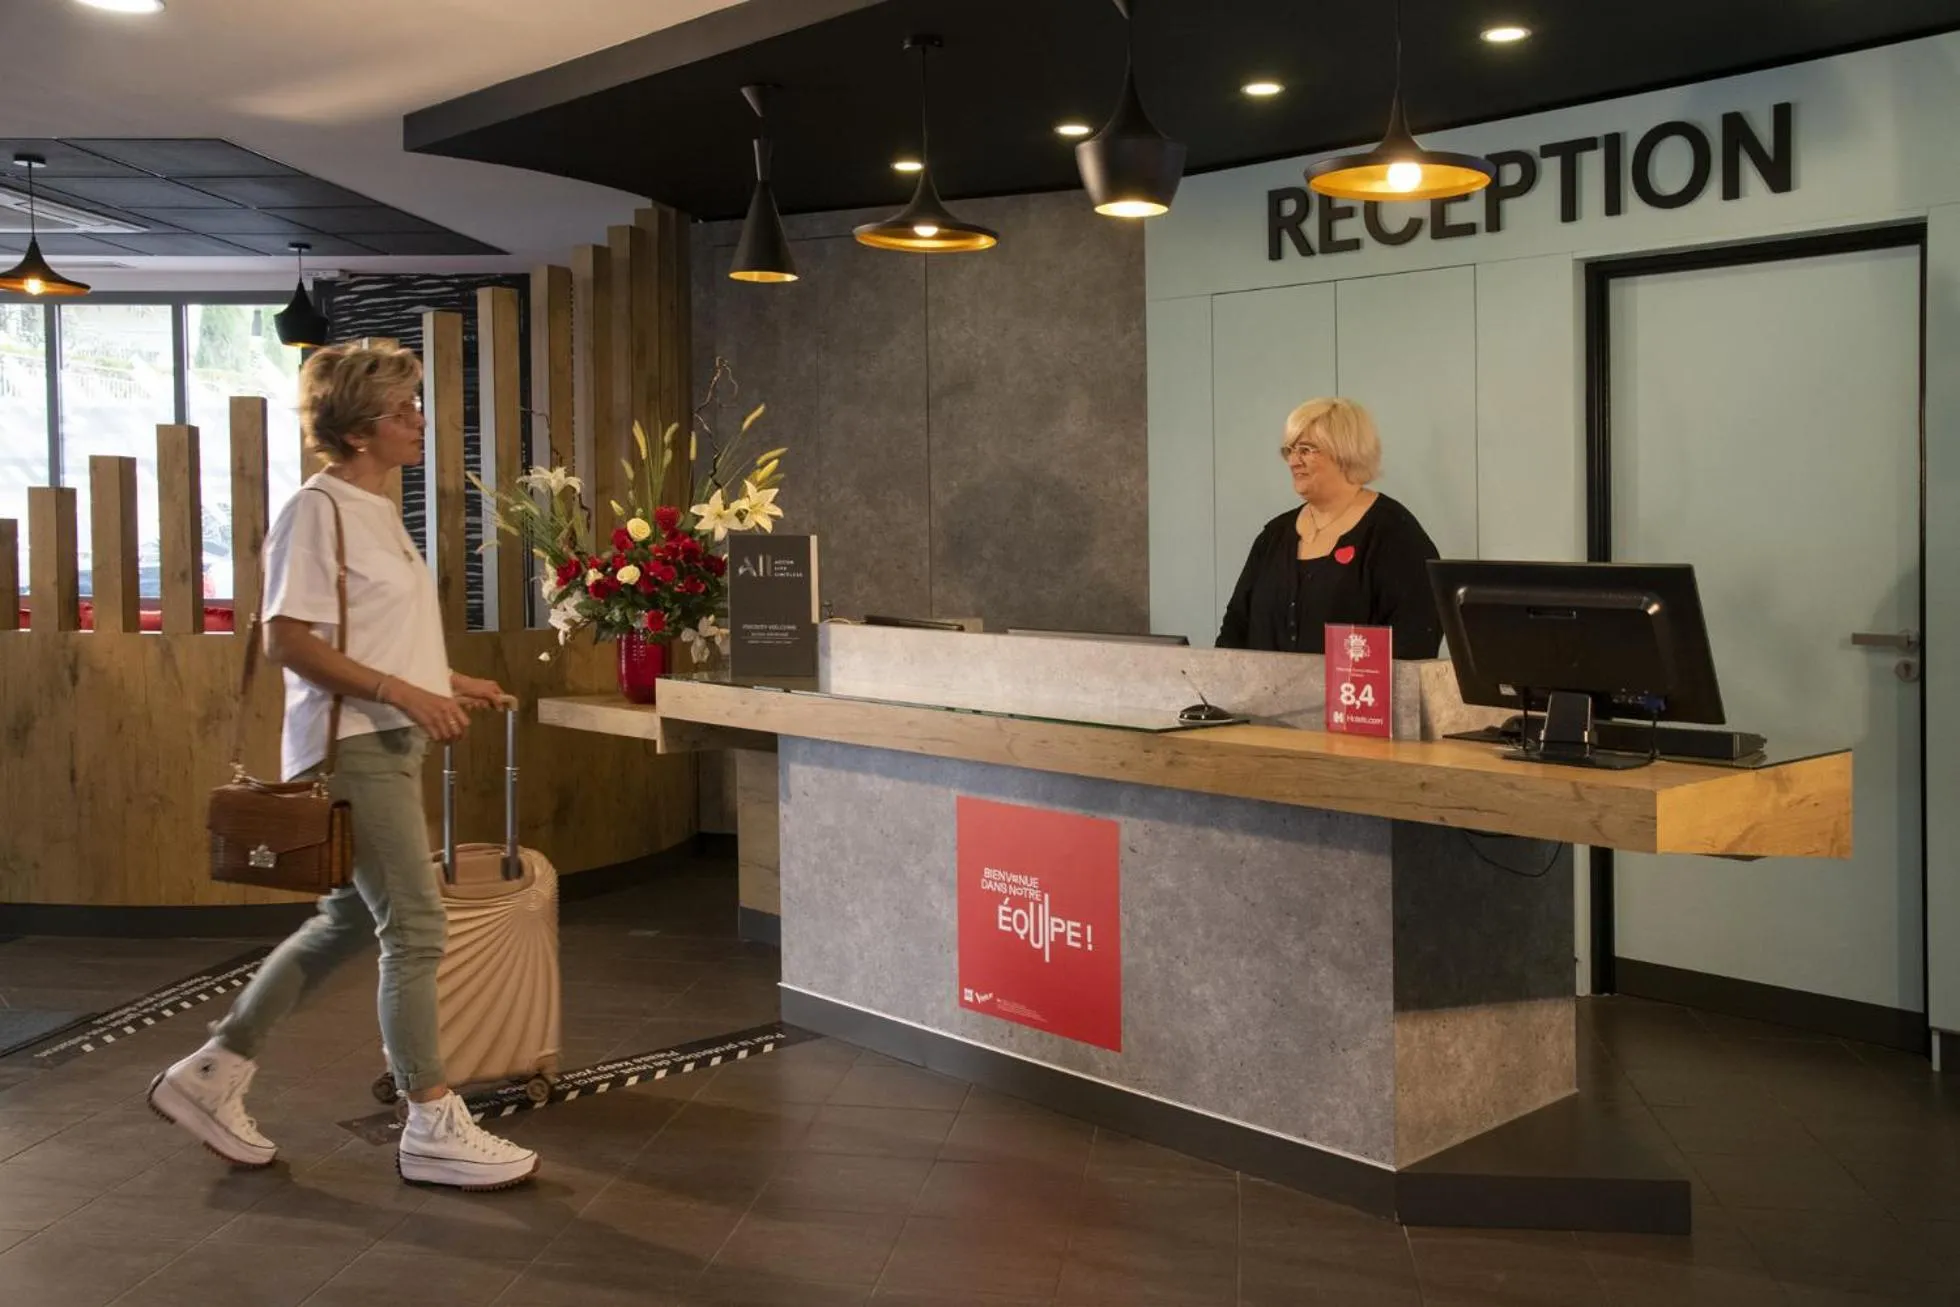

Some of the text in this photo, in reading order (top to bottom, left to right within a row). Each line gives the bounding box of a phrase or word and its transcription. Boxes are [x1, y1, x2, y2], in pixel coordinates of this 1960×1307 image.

[1268, 102, 1793, 261] RECEPTION
[1340, 683, 1374, 709] 8,4
[980, 878, 1007, 894] DANS
[998, 893, 1082, 963] ÉQUIPE
